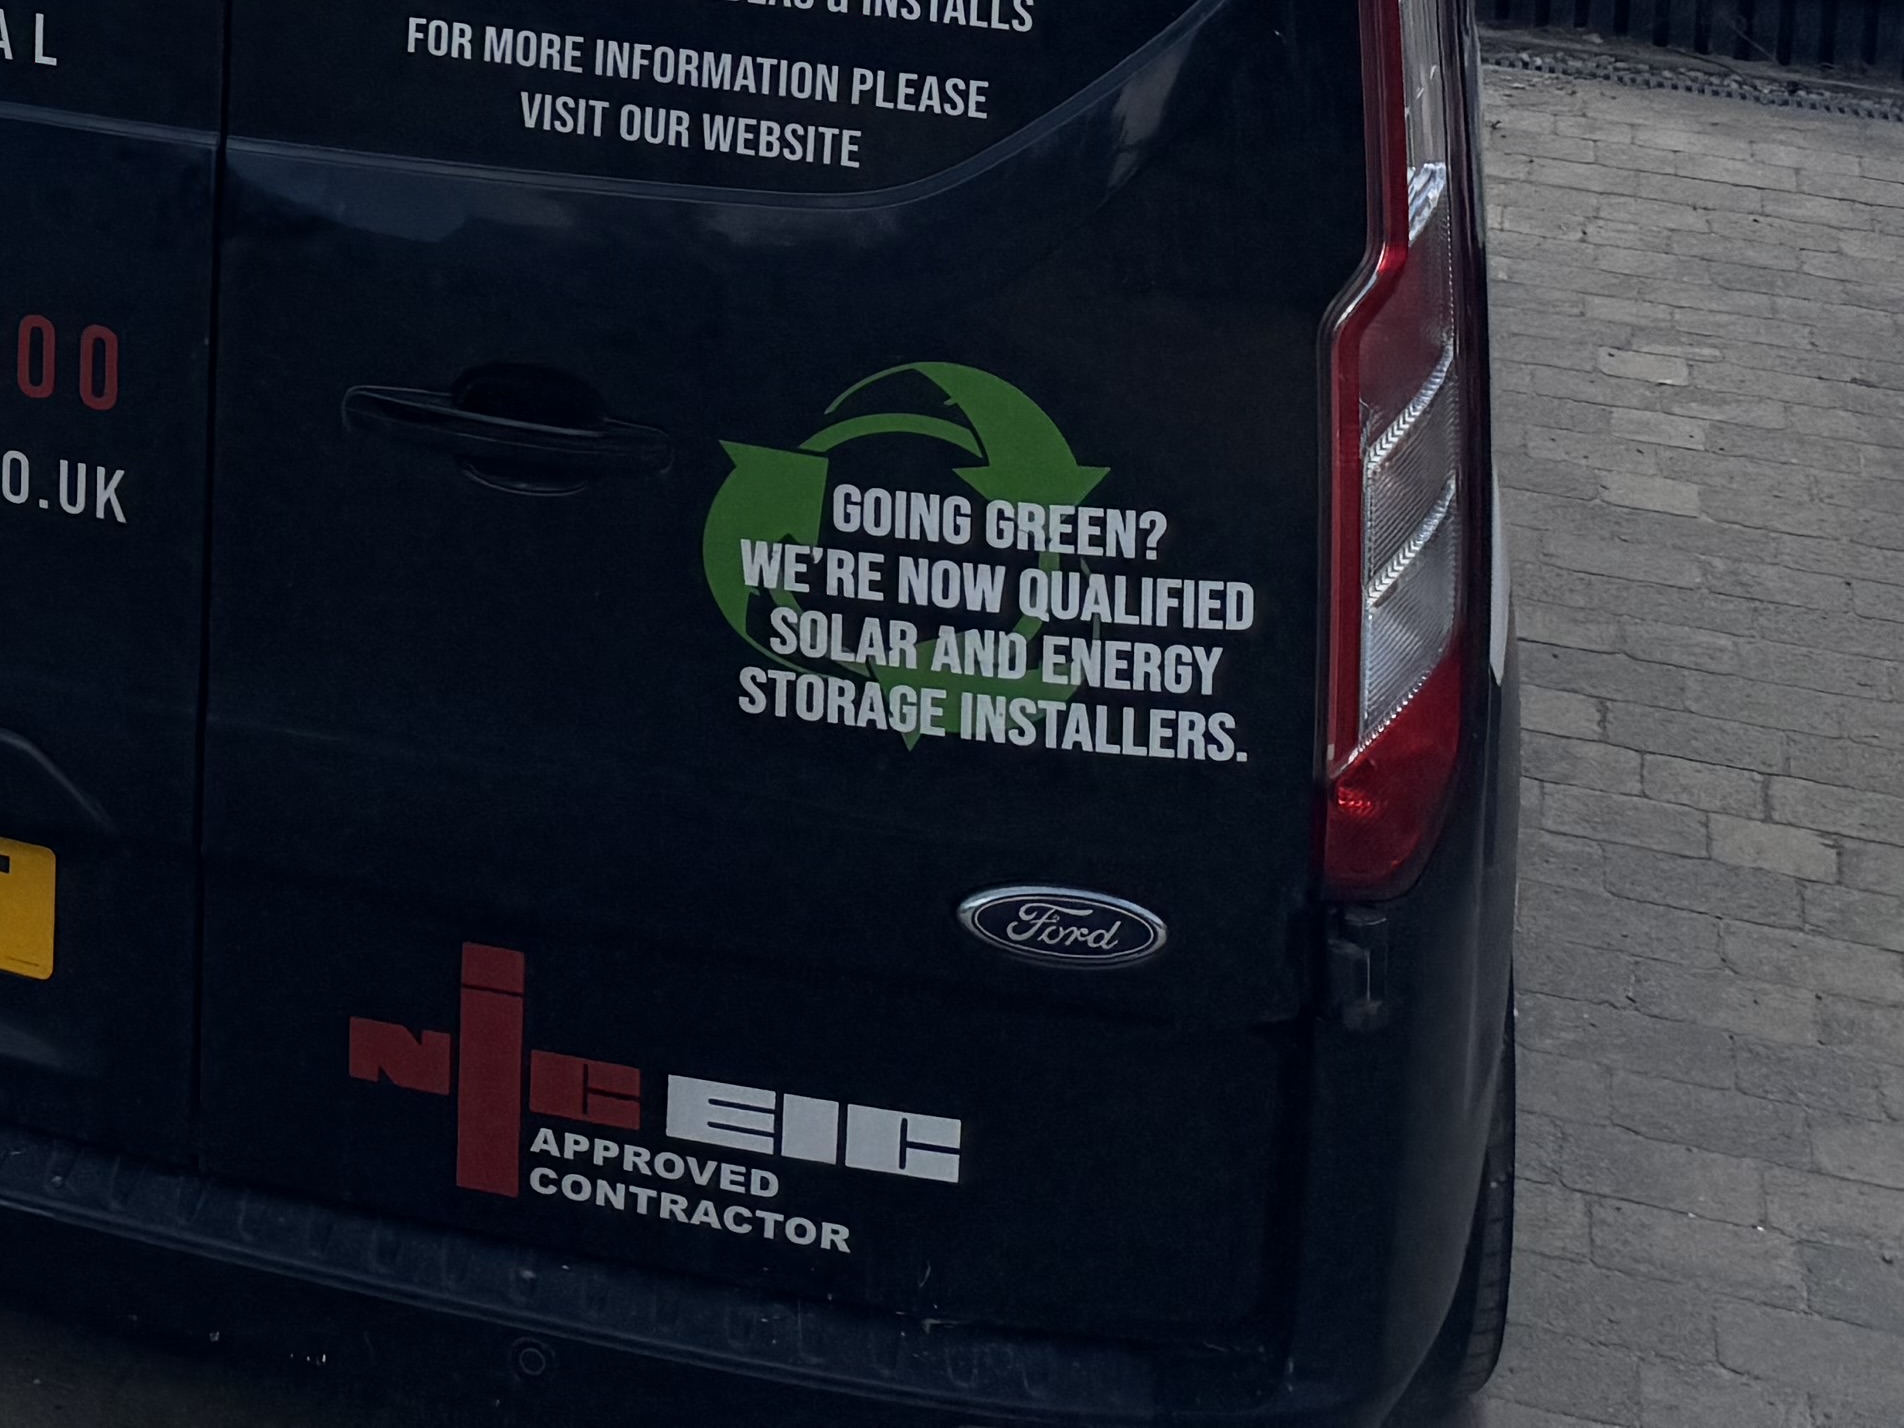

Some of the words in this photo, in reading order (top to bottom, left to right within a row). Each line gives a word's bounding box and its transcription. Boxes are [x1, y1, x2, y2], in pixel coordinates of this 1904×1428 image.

[408, 17, 472, 59] FOR
[484, 26, 584, 73] MORE
[595, 40, 838, 102] INFORMATION
[852, 68, 988, 119] PLEASE
[521, 92, 609, 136] VISIT
[620, 105, 689, 147] OUR
[703, 114, 861, 168] WEBSITE
[834, 484, 971, 544] GOING
[986, 500, 1167, 560] GREEN?
[741, 539, 884, 600] WE'RE
[899, 556, 1005, 613] NOW
[1019, 568, 1254, 630] QUALIFIED
[770, 607, 917, 669] SOLAR
[931, 626, 1026, 679] AND
[1042, 635, 1223, 695] ENERGY
[739, 667, 946, 736] STORAGE
[961, 692, 1247, 761] INSTALLERS.
[1007, 903, 1121, 949] Ford
[530, 1128, 778, 1197] APPROVED
[530, 1168, 850, 1253] CONTRACTOR
